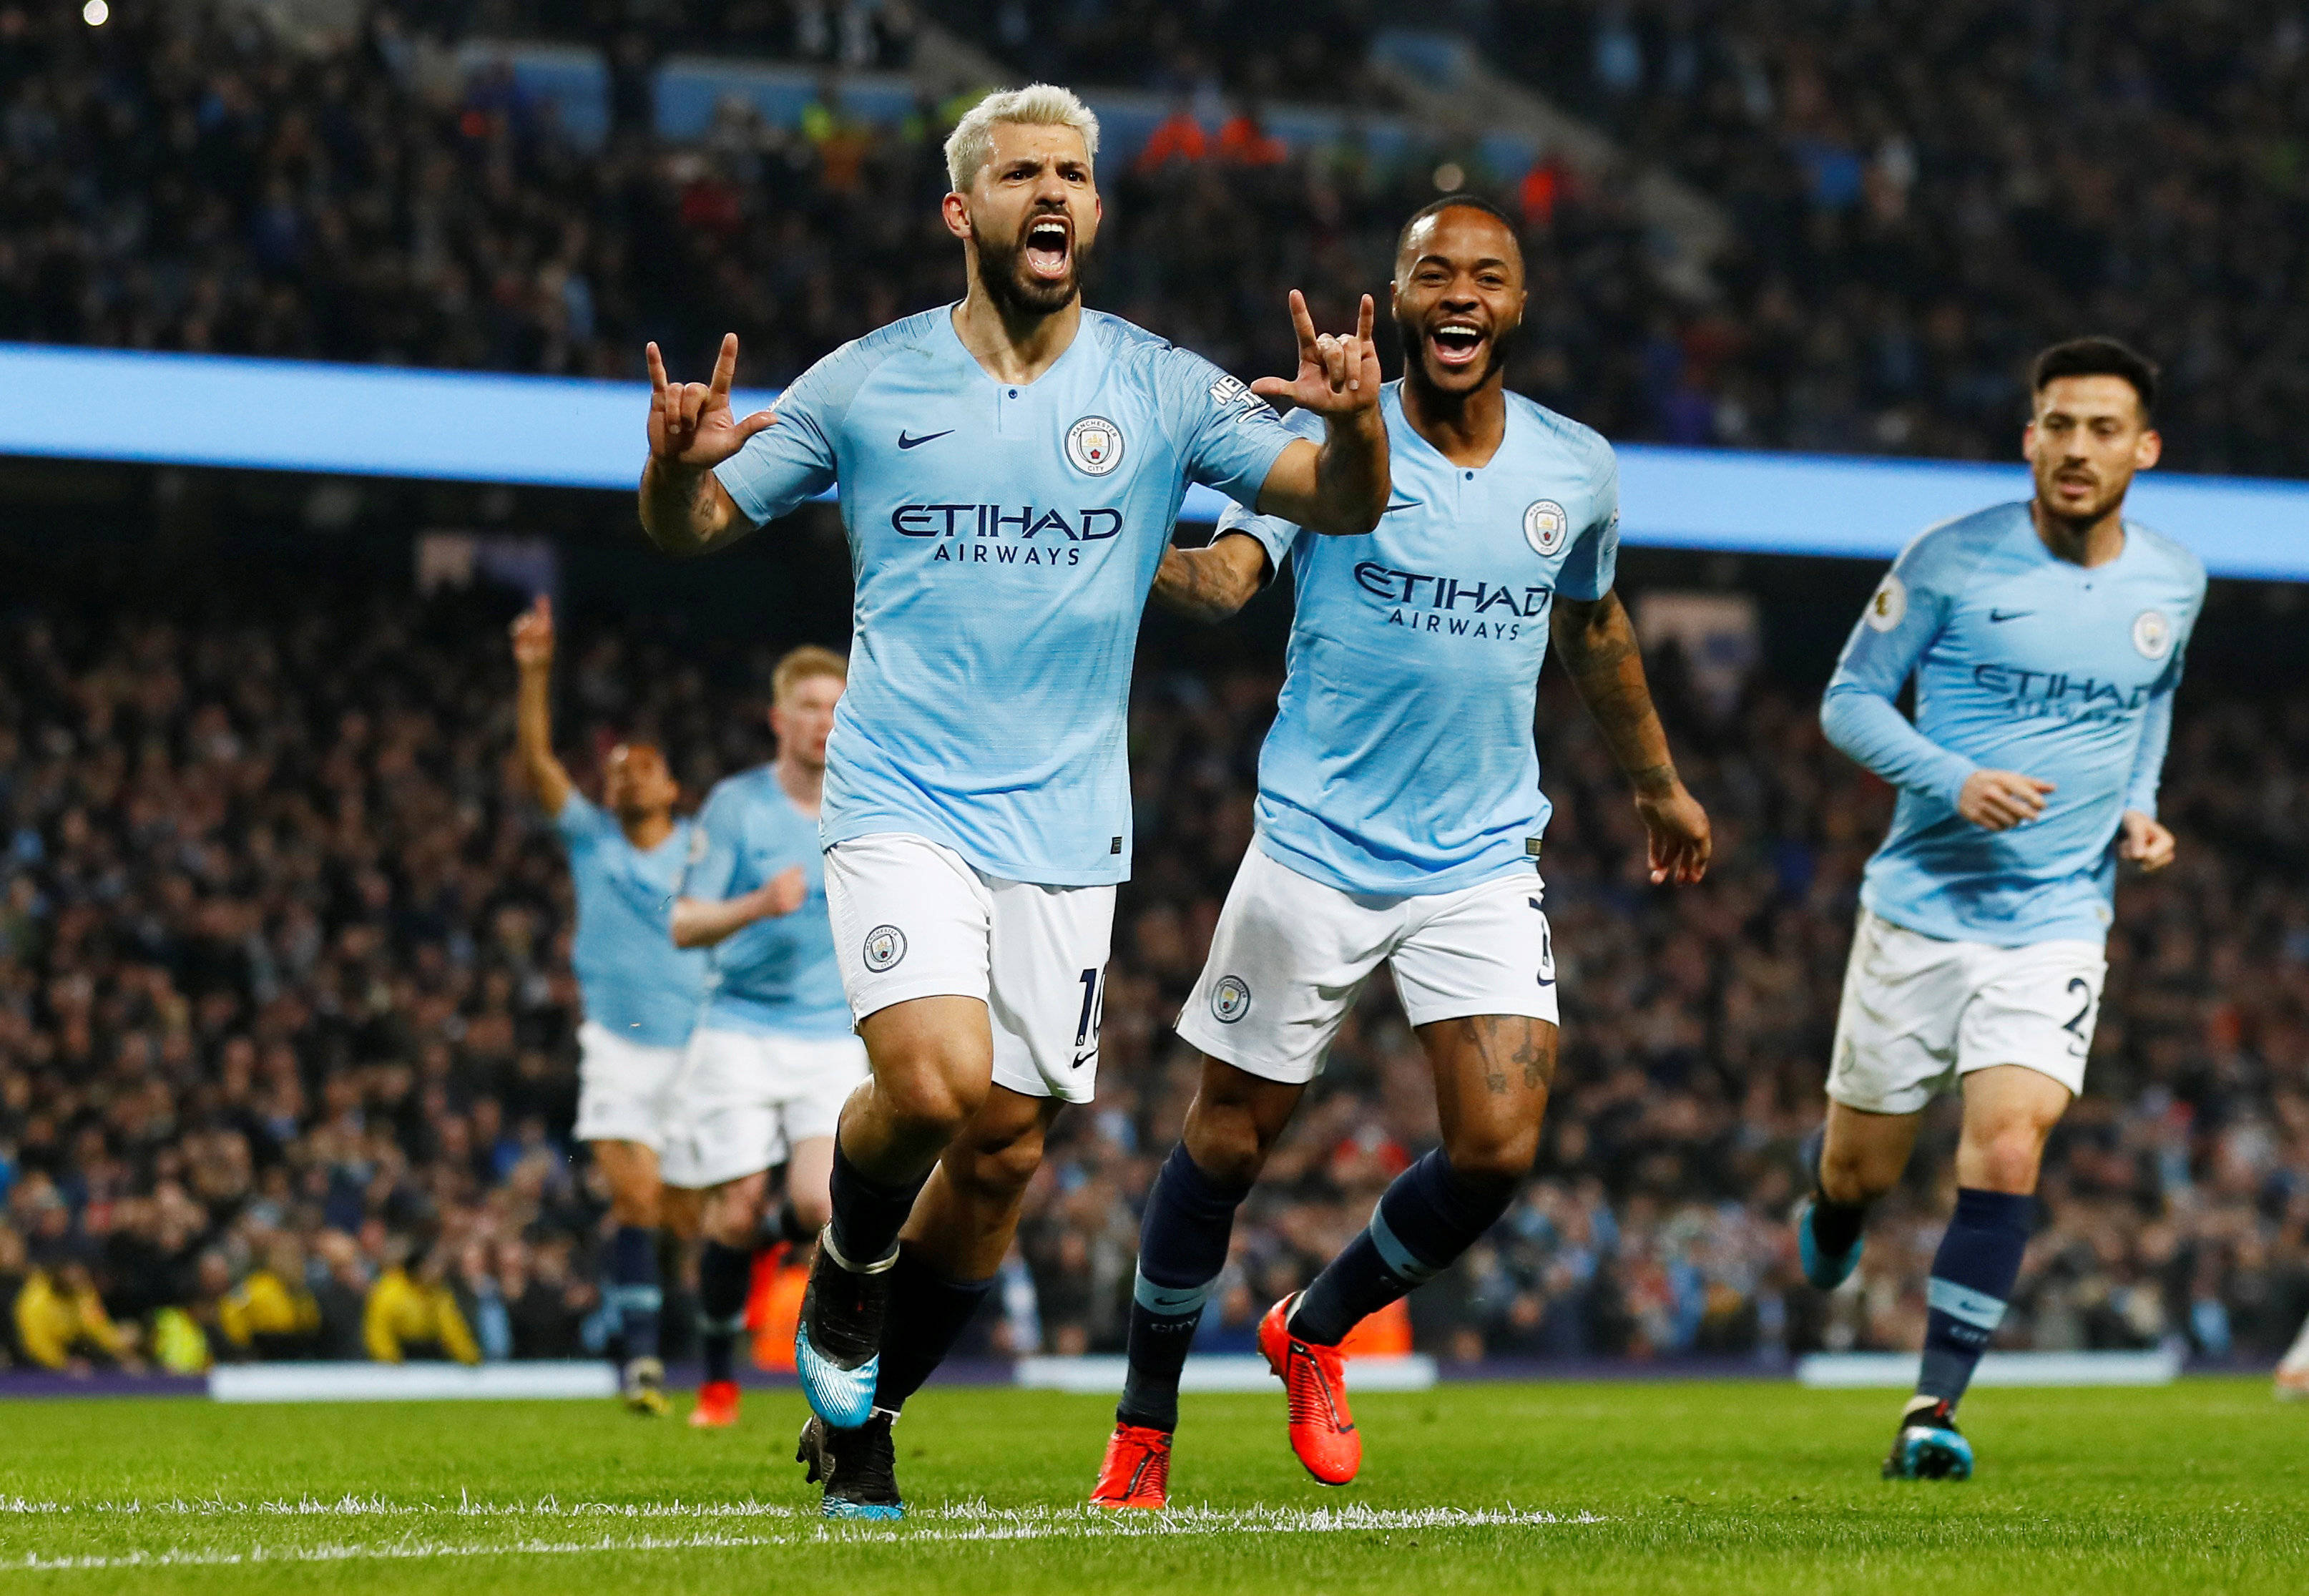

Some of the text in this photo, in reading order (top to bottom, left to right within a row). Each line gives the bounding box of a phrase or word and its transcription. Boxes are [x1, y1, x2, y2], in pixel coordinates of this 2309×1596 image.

[1072, 421, 1117, 438] MANCHESTER
[891, 504, 1123, 541] ETIHAD
[934, 544, 1080, 566] AIRWAYS
[1353, 562, 1551, 617] ETIHAD
[1388, 608, 1520, 641] AIRWAYS
